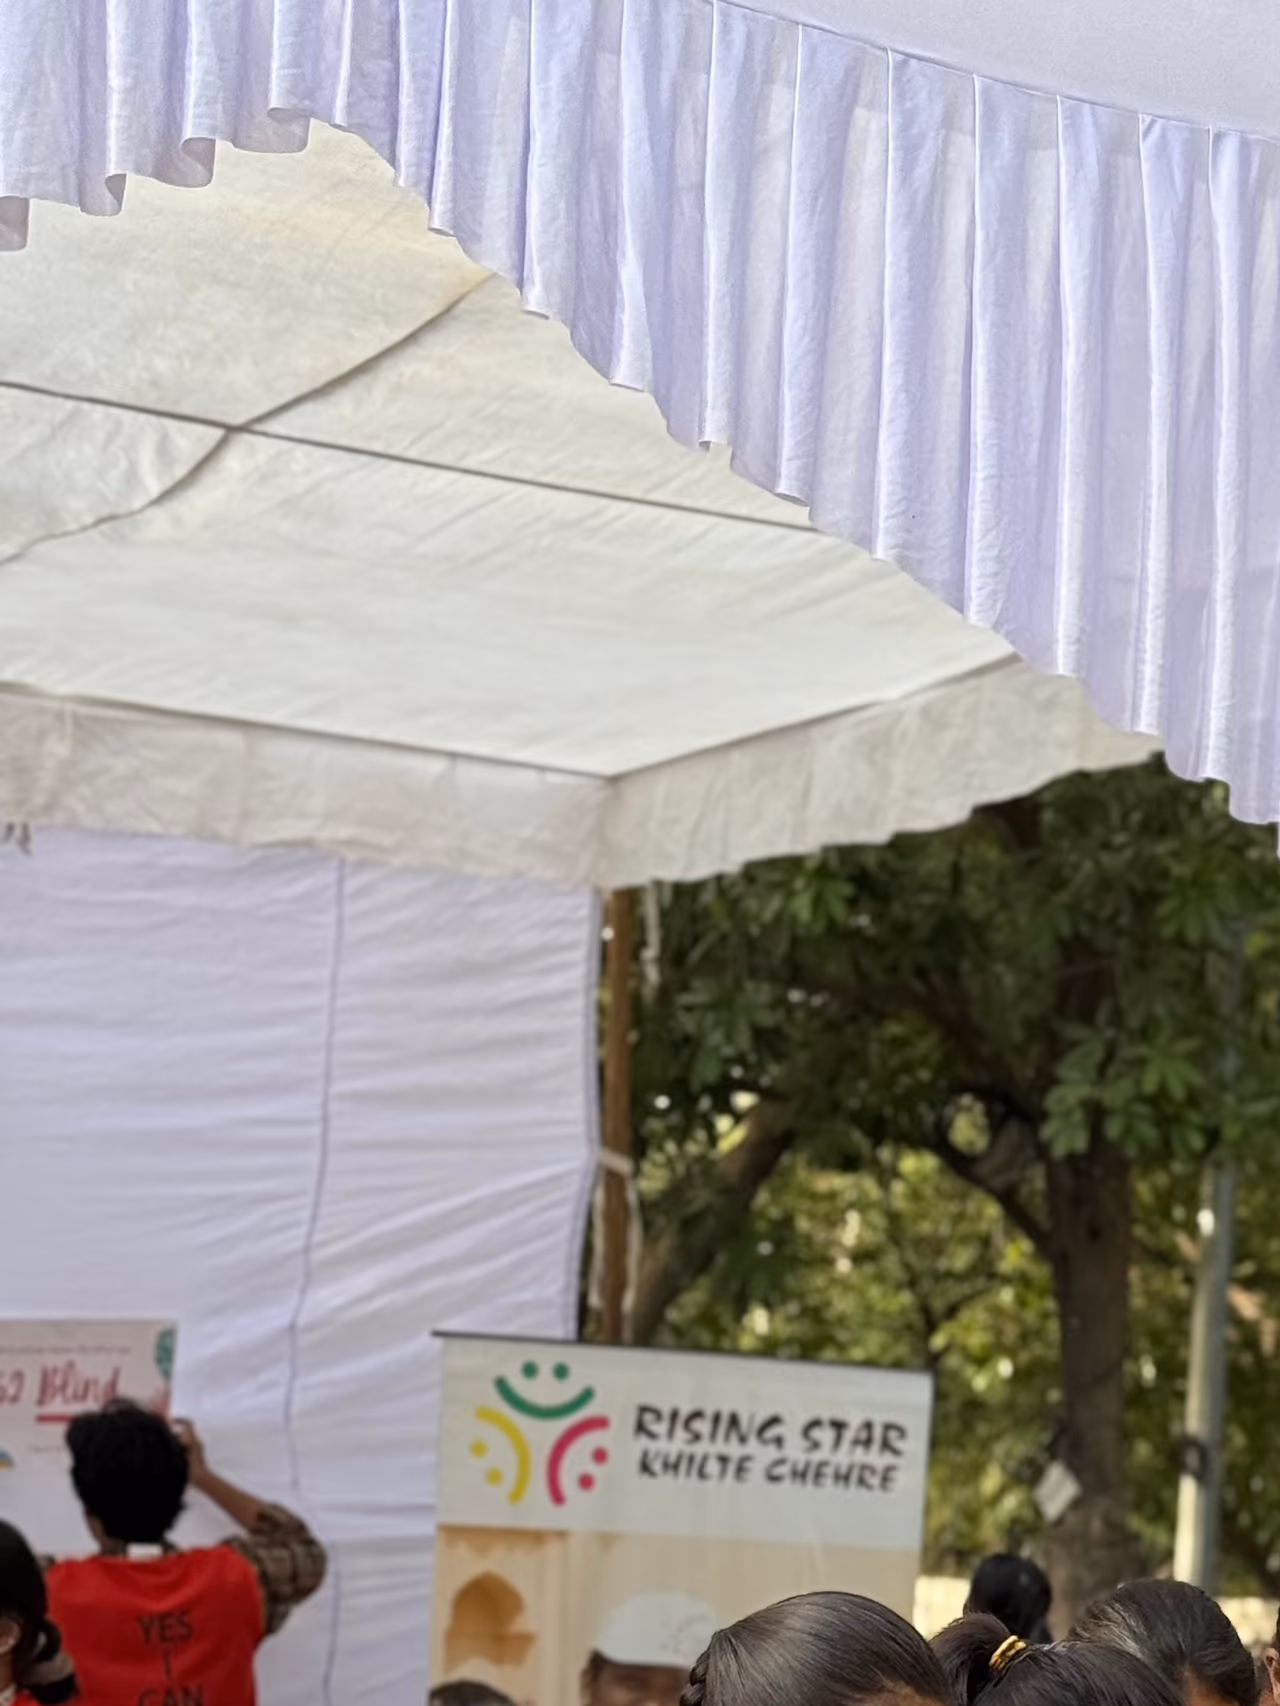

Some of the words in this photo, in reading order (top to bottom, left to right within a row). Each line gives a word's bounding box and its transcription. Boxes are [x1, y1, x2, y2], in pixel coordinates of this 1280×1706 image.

[634, 1405, 784, 1449] RISING
[801, 1416, 907, 1456] STAR
[640, 1449, 753, 1484] KHILTE
[764, 1457, 900, 1492] CHEHRE
[136, 1609, 194, 1645] YES
[162, 1649, 172, 1681] I
